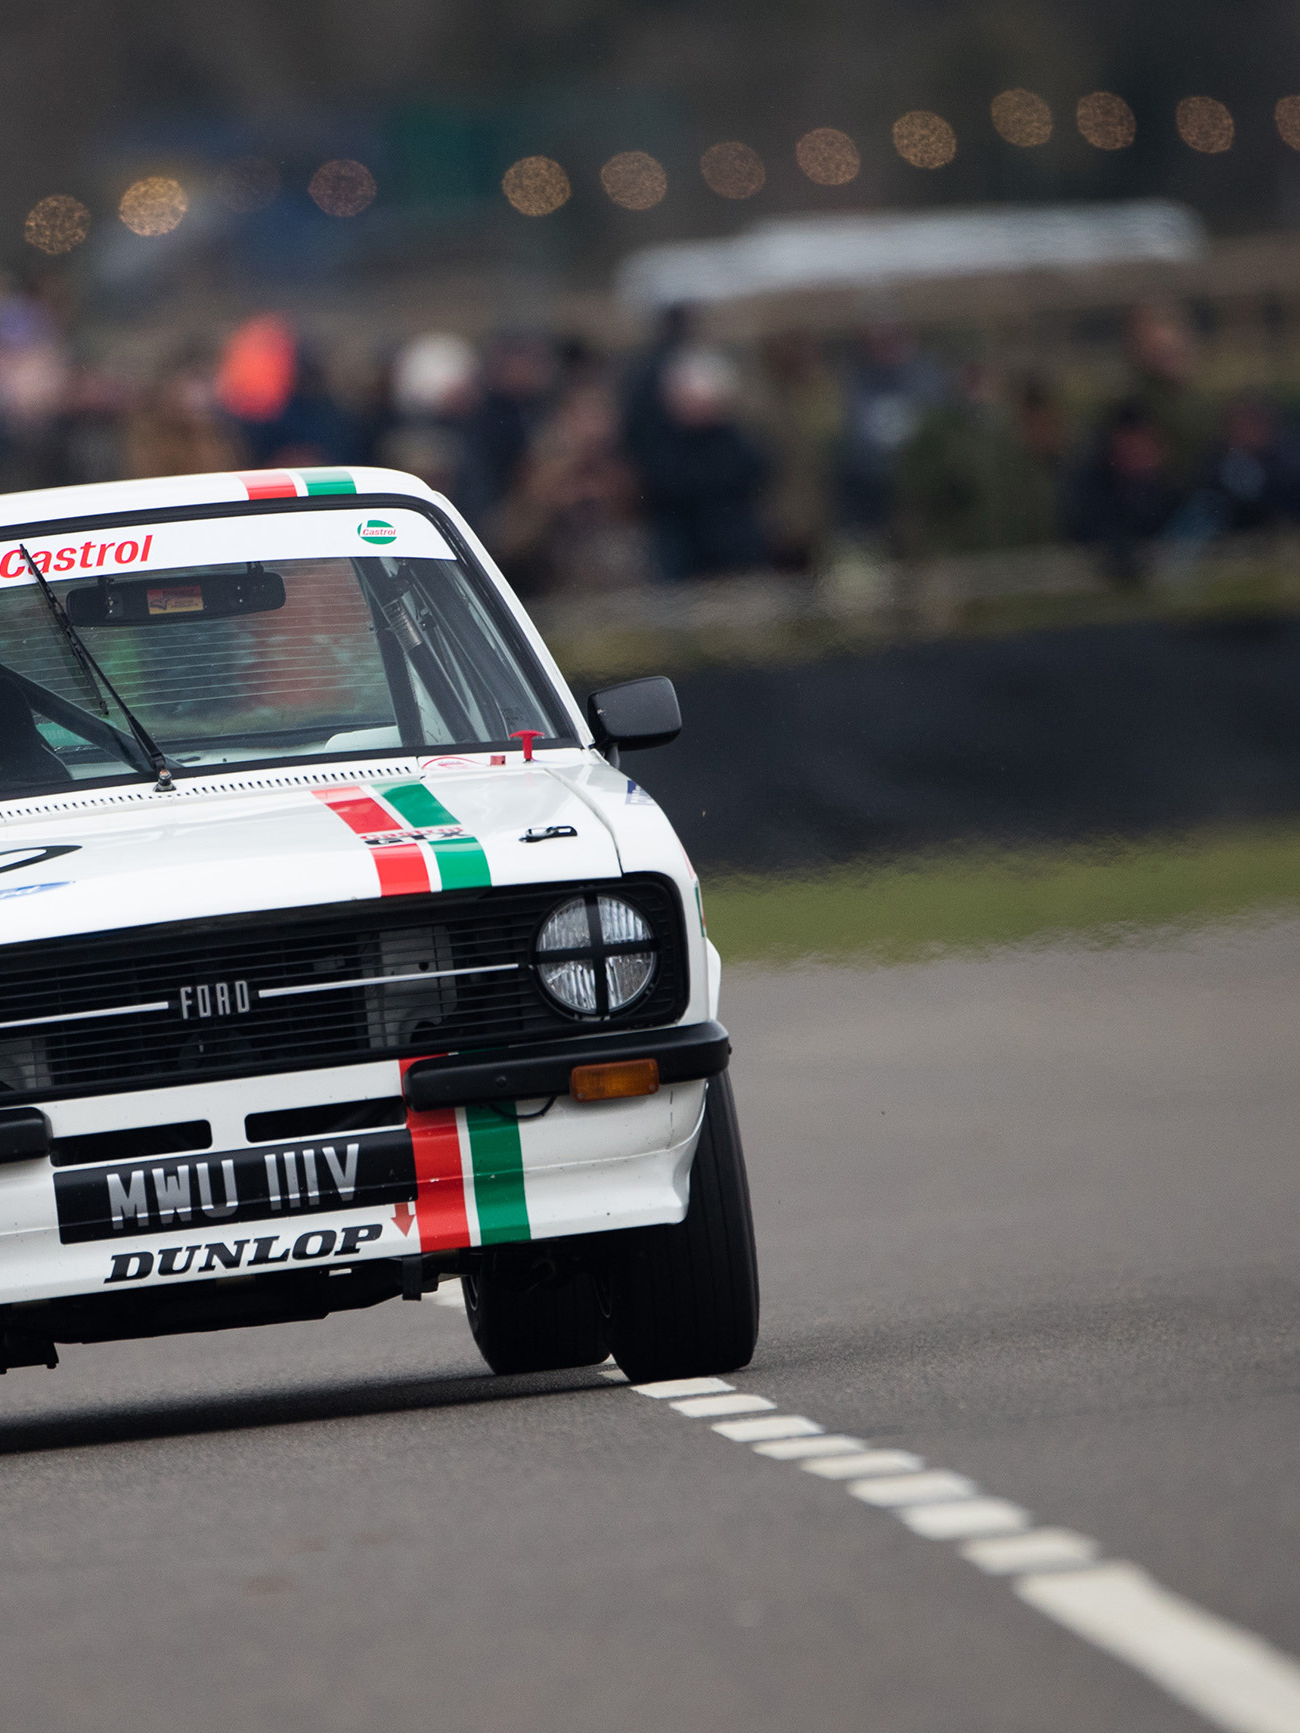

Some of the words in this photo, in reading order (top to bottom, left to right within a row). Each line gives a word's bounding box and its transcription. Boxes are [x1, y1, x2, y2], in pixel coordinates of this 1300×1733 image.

[362, 528, 397, 536] Castrol
[180, 980, 250, 1020] FORD
[106, 1159, 239, 1230] MWU
[103, 1224, 383, 1284] DUNLOP
